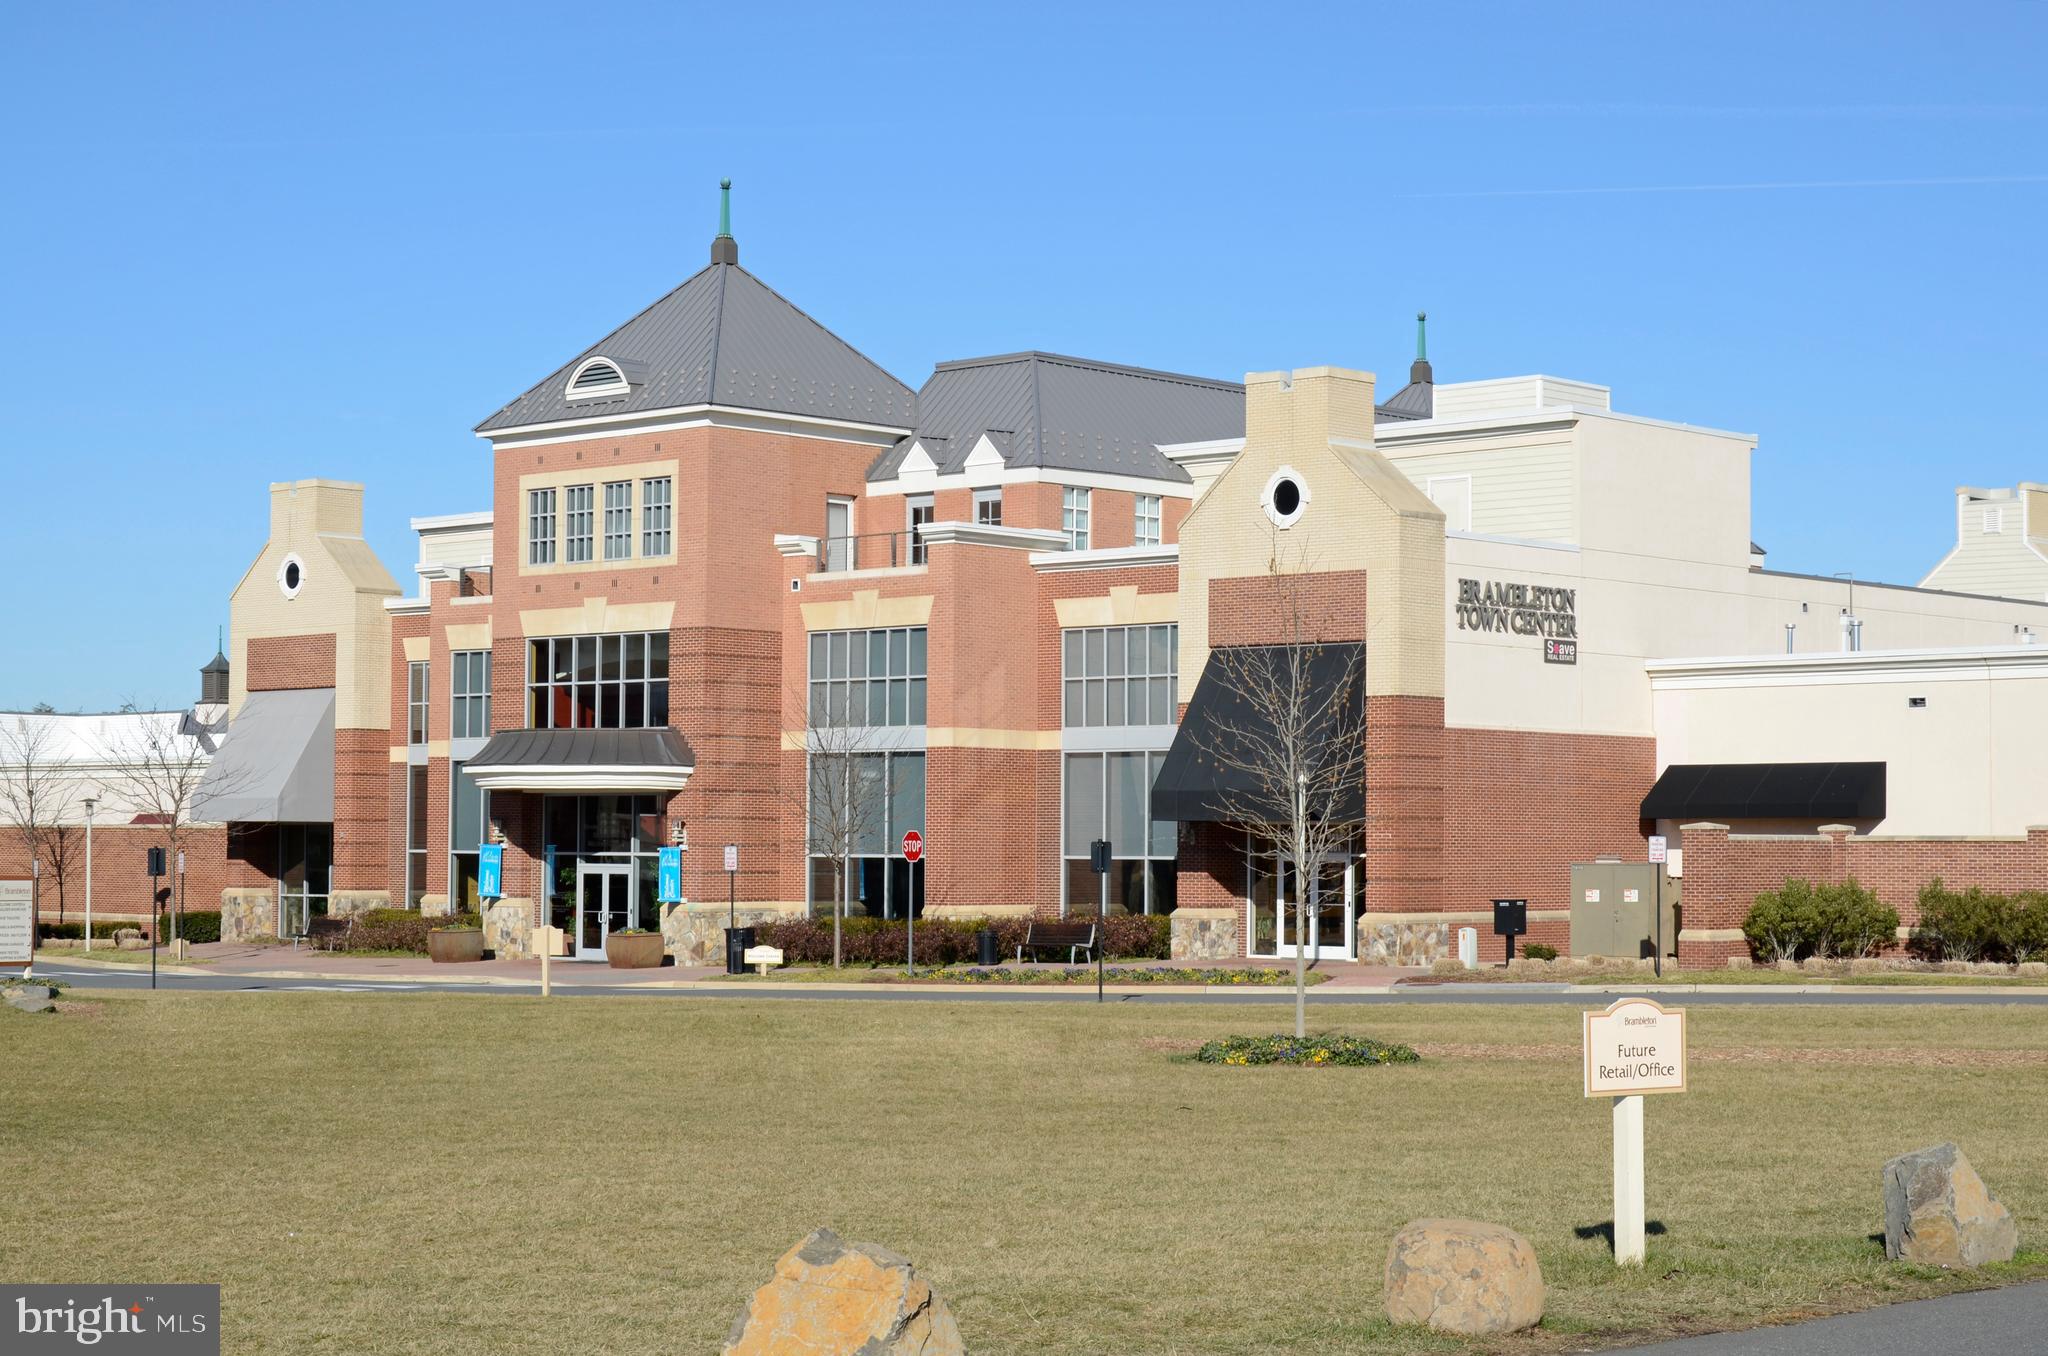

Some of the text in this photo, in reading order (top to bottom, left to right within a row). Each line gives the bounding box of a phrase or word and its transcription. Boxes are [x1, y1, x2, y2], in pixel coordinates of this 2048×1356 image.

[1458, 578, 1576, 614] BRAMBLETON
[1455, 604, 1578, 639] TOWN CENTER
[904, 840, 921, 852] STOP
[1624, 1016, 1657, 1026] Brambleton
[1618, 1044, 1656, 1058] Future
[1599, 1062, 1675, 1080] Retail/Office
